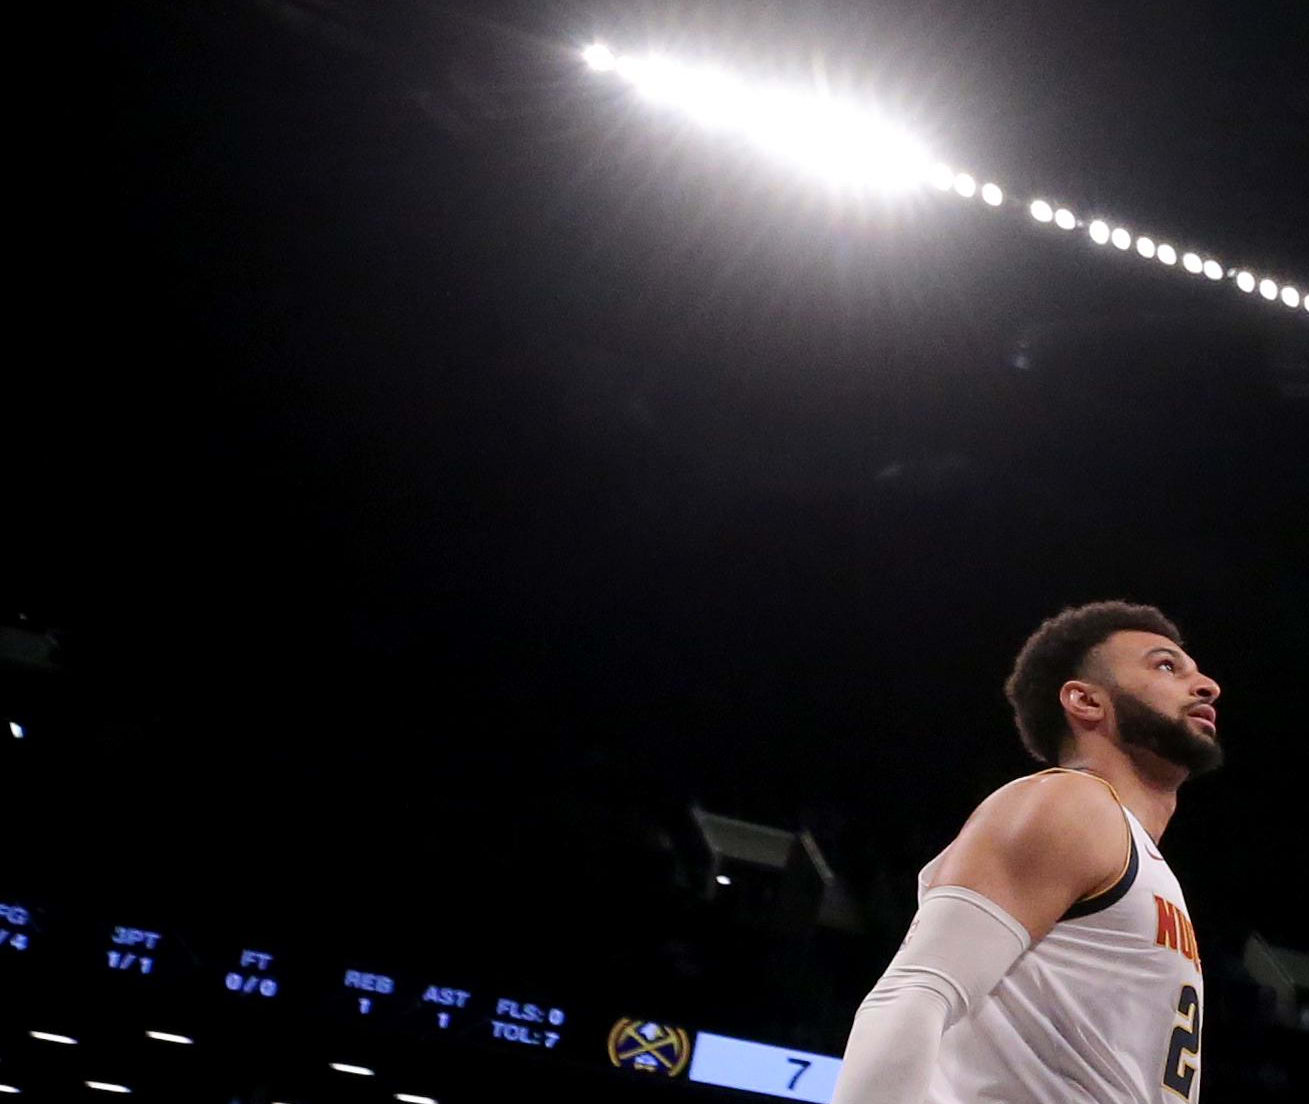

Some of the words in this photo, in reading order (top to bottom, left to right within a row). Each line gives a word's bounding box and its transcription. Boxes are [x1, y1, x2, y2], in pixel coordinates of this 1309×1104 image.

[111, 926, 161, 949] 3PT
[241, 951, 272, 969] FT
[345, 971, 394, 993] REB
[360, 999, 371, 1013] 1
[424, 987, 470, 1006] AST
[439, 1013, 450, 1027] 1
[495, 999, 544, 1023] FLS:
[545, 1032, 560, 1047] 7
[1161, 984, 1200, 1104] 2
[787, 1058, 811, 1090] 7
